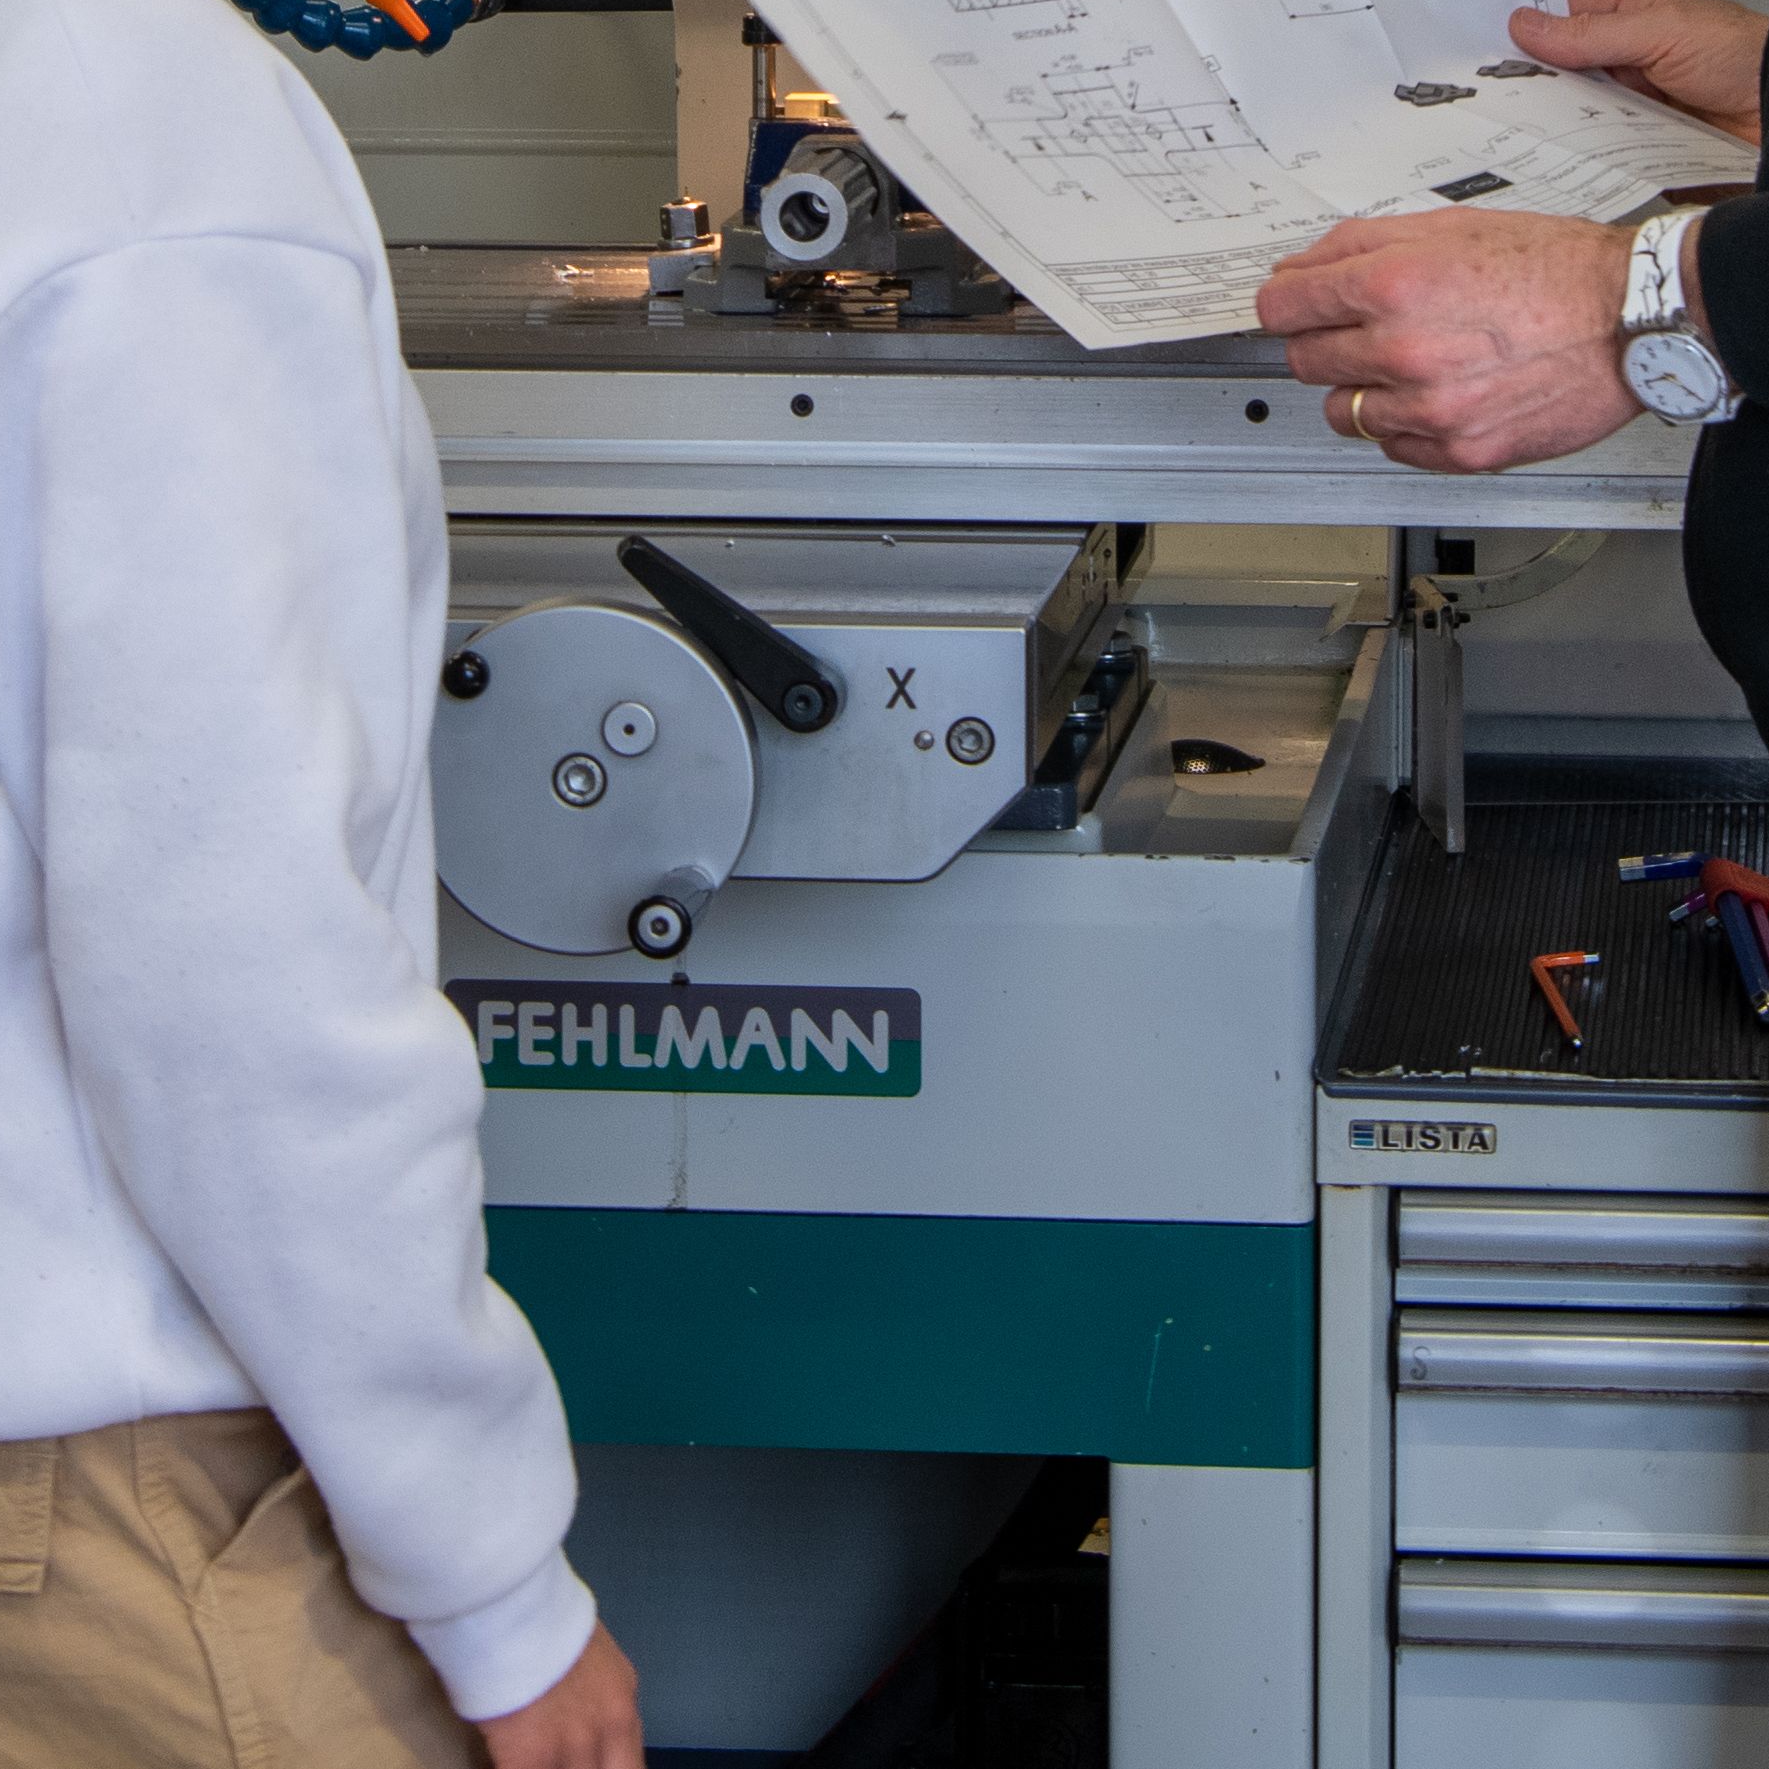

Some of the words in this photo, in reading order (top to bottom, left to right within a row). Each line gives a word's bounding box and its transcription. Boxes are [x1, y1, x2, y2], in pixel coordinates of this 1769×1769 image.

[885, 667, 918, 711] X
[477, 1000, 890, 1074] FEHLMANN
[1379, 1124, 1491, 1152] LISTA
